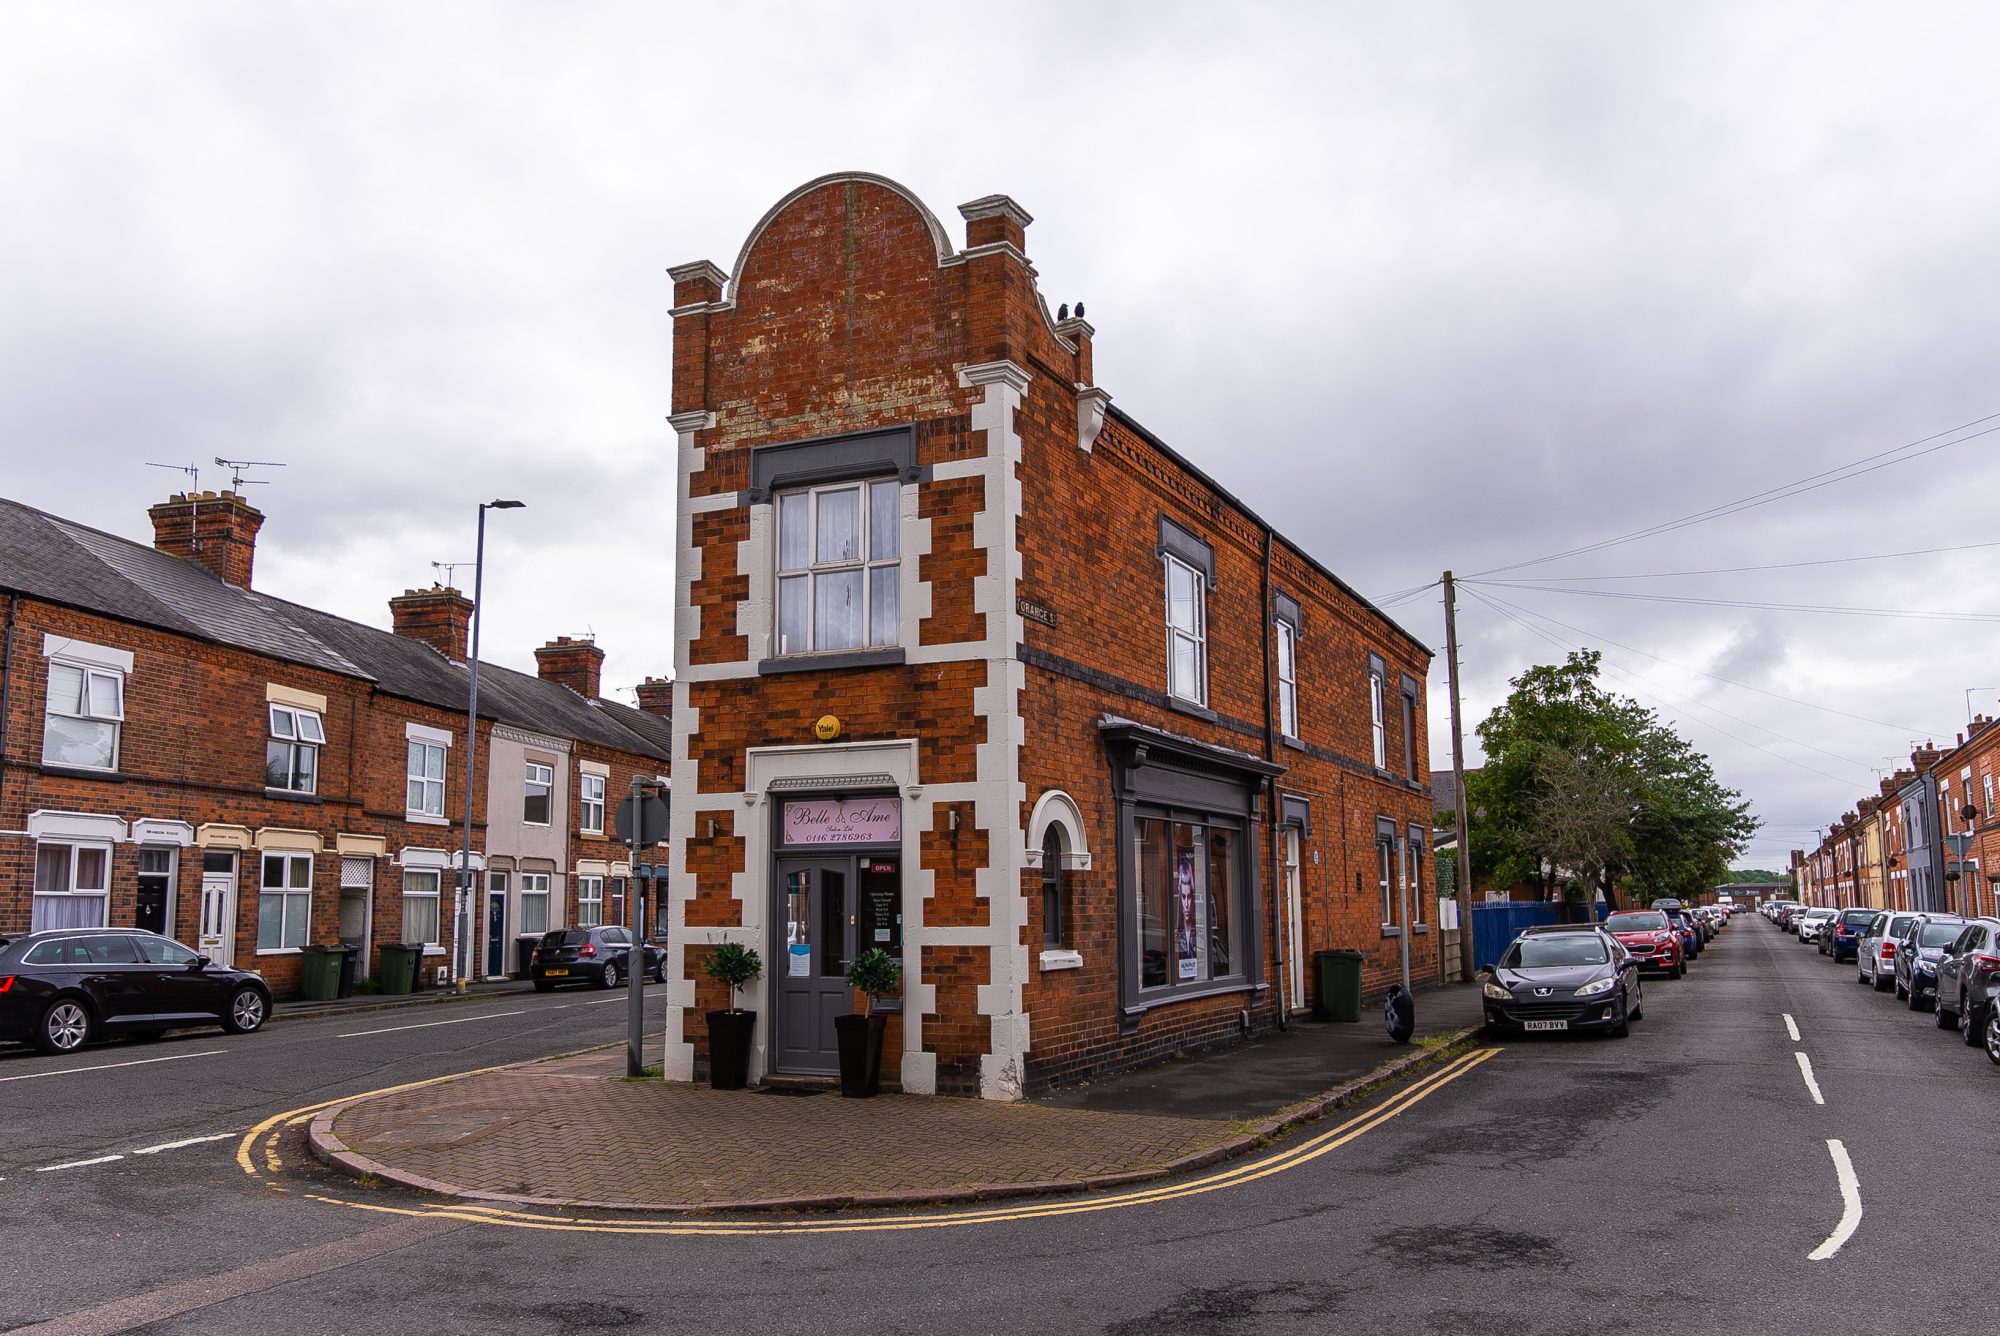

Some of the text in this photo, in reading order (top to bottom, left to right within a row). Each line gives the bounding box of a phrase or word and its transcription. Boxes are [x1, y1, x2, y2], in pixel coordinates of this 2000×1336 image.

[1020, 601, 1048, 620] ORANGE
[793, 807, 830, 825] Belle
[806, 833, 872, 842] 0116 2786963
